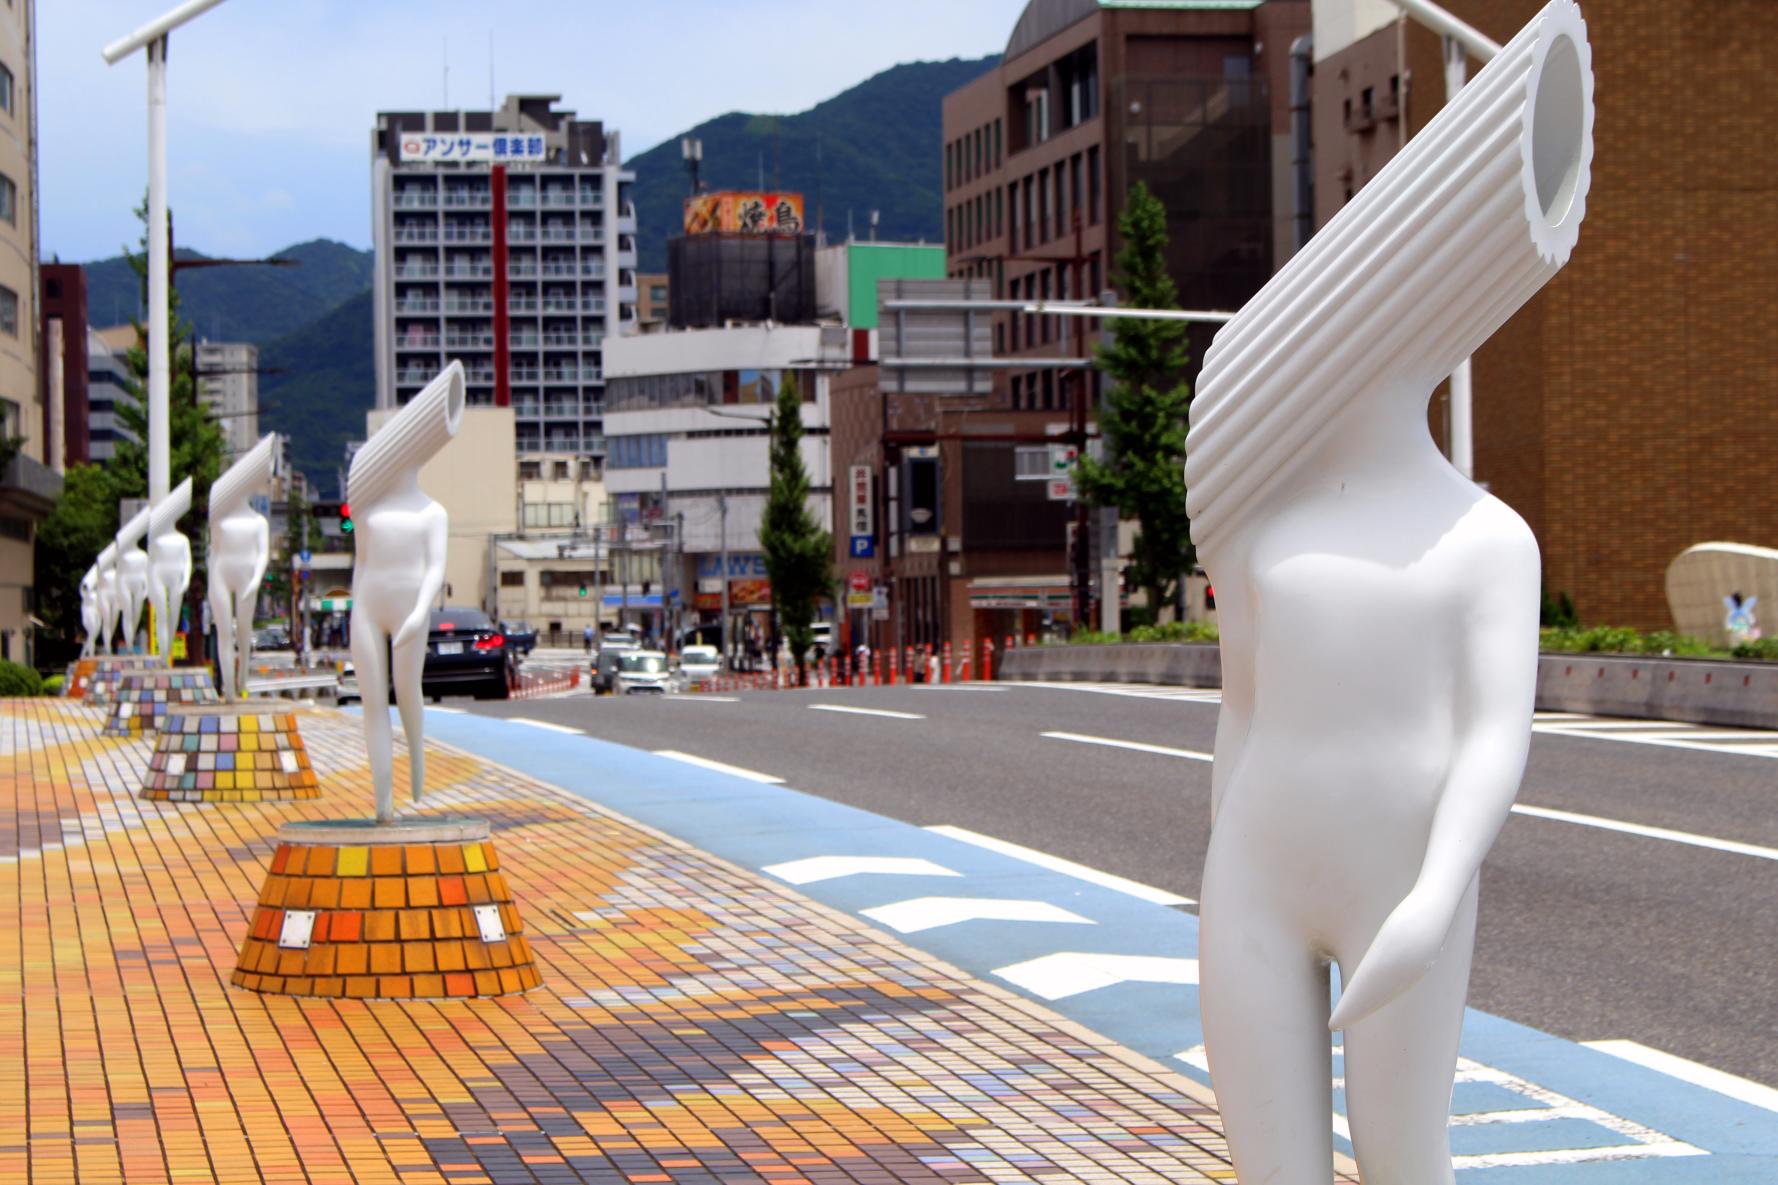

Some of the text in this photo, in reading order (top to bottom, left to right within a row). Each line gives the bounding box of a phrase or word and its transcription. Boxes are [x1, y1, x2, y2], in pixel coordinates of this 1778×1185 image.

[422, 137, 543, 156] アンサー倶楽部
[856, 539, 868, 555] P
